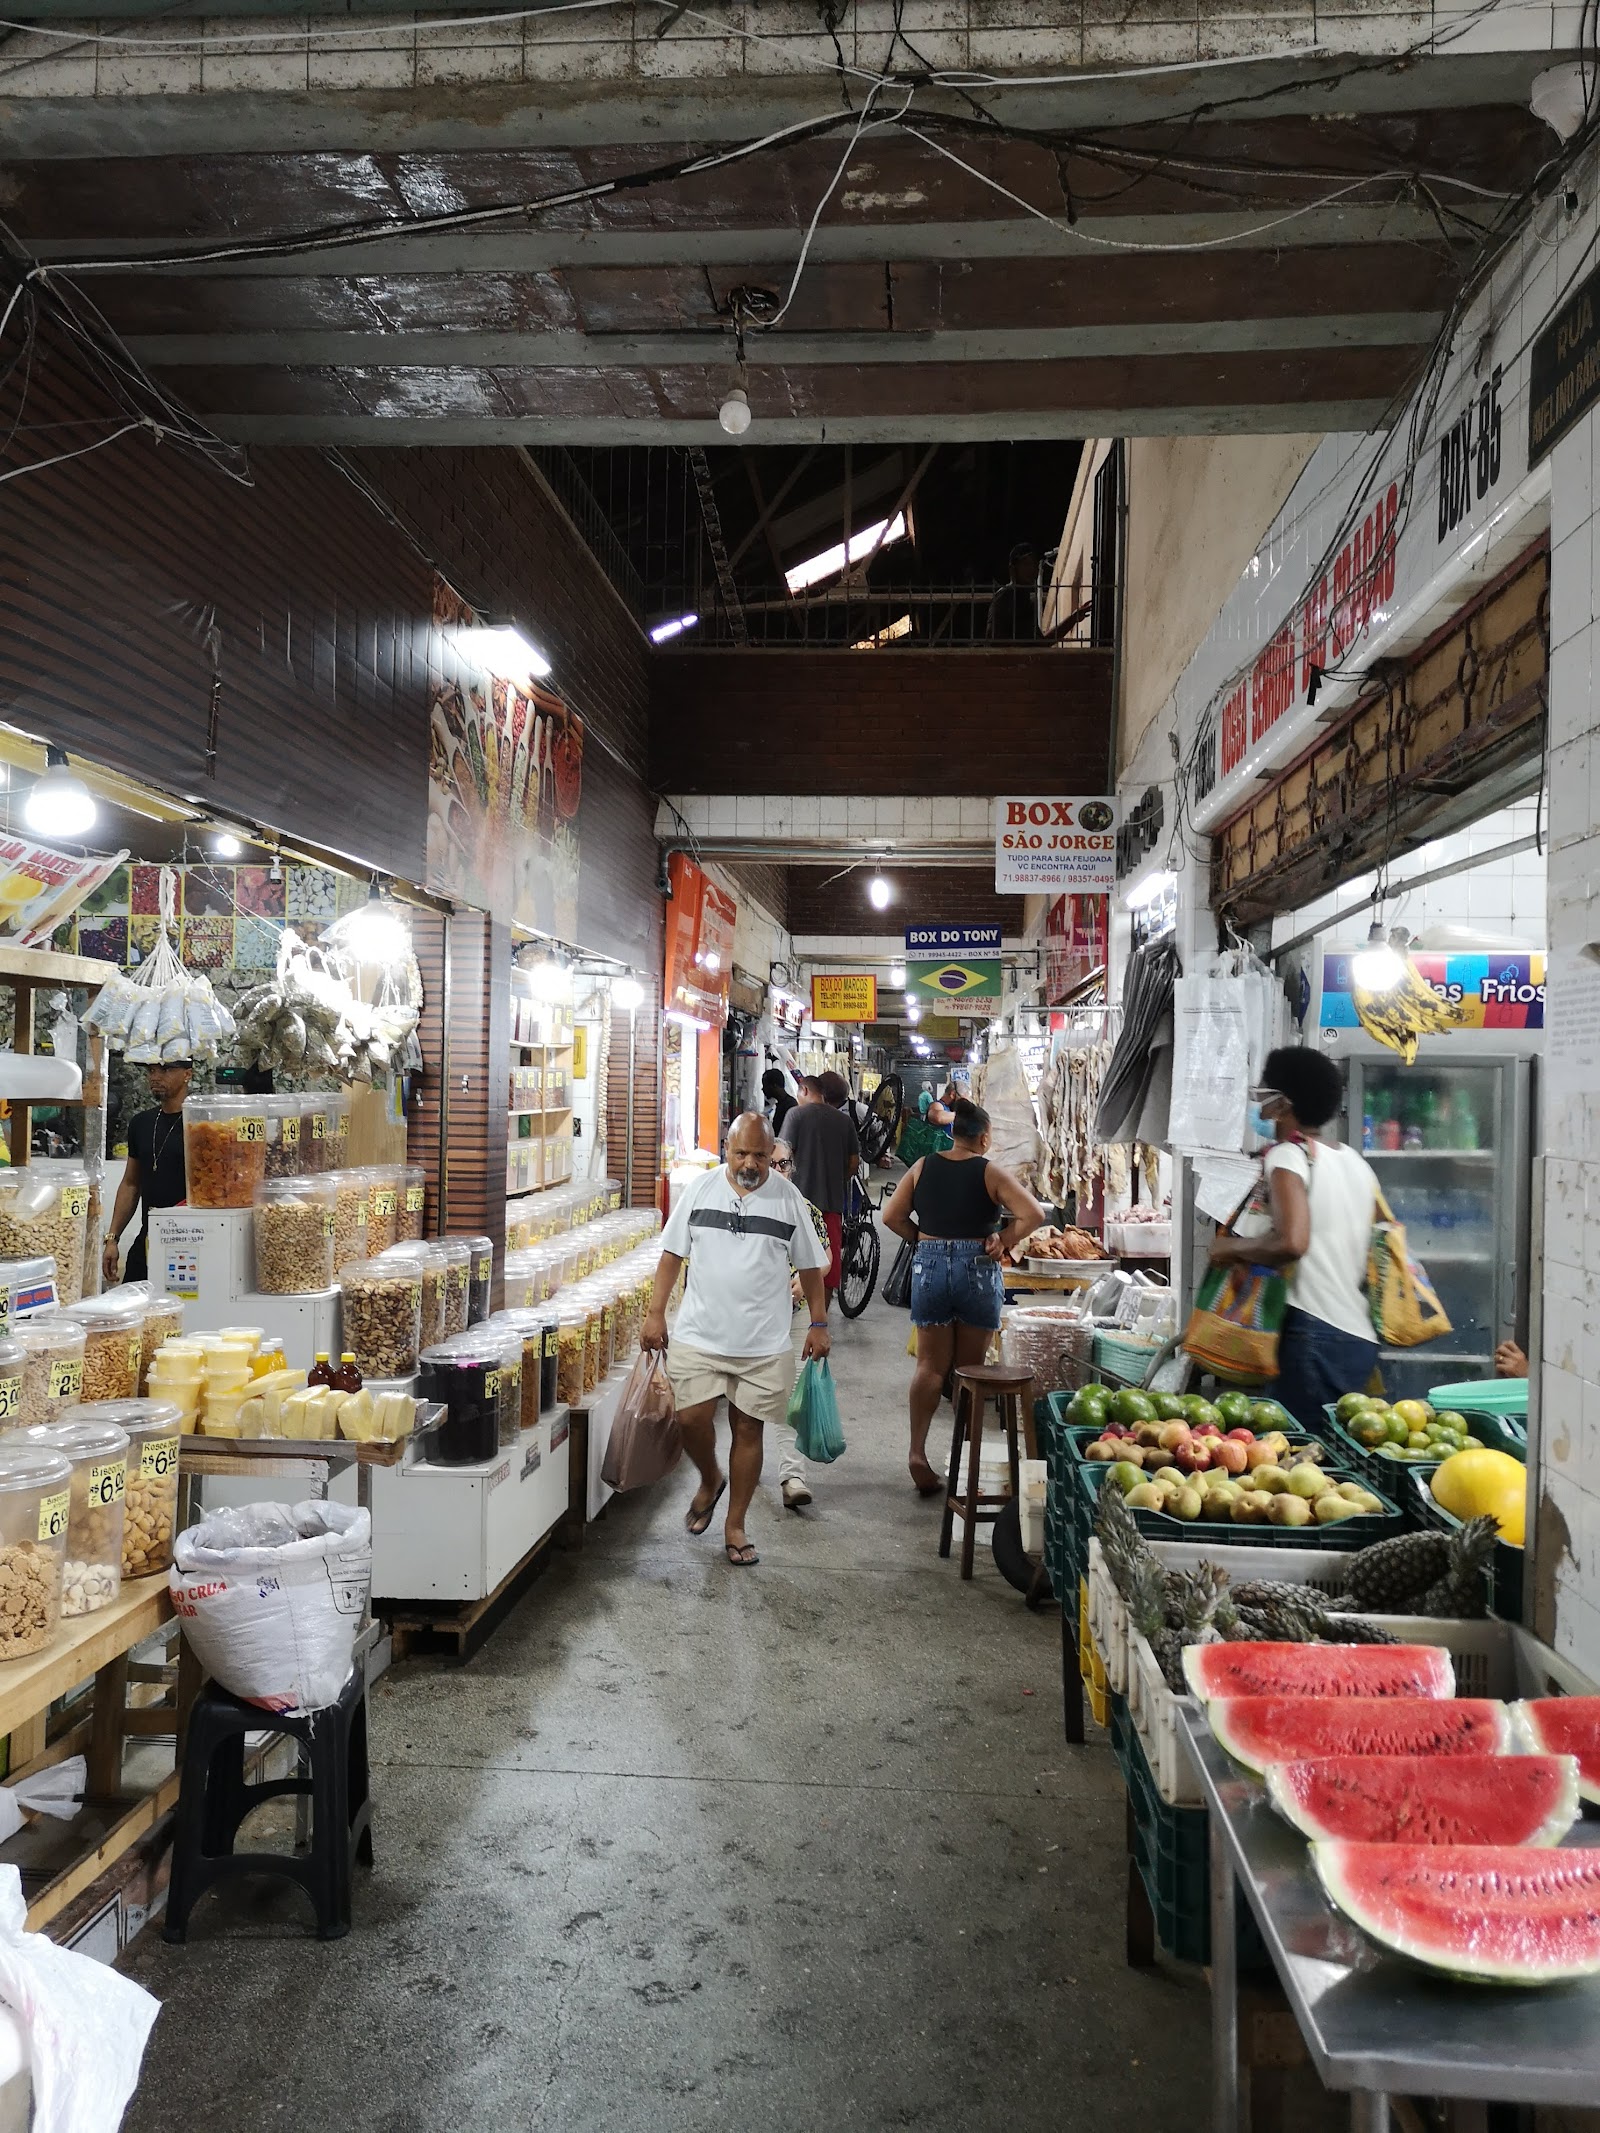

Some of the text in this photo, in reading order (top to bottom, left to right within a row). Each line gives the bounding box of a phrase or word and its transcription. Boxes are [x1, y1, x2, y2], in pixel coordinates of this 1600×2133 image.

[1557, 294, 1594, 363] RUA
[1221, 678, 1247, 781] NOSSA
[1252, 612, 1295, 745] SENHORA
[1006, 801, 1075, 826] BOX
[1002, 830, 1115, 850] SÃO JORGE
[1008, 854, 1030, 862] TUDO
[1054, 855, 1071, 863] SUA
[1072, 855, 1113, 863] FEIJOADA
[1017, 863, 1097, 872] VC ENCONTRA AQUI
[909, 929, 999, 944] BOX DO TONY
[820, 977, 868, 991] BOX DO MARCOS
[188, 1581, 227, 1601] CRUA
